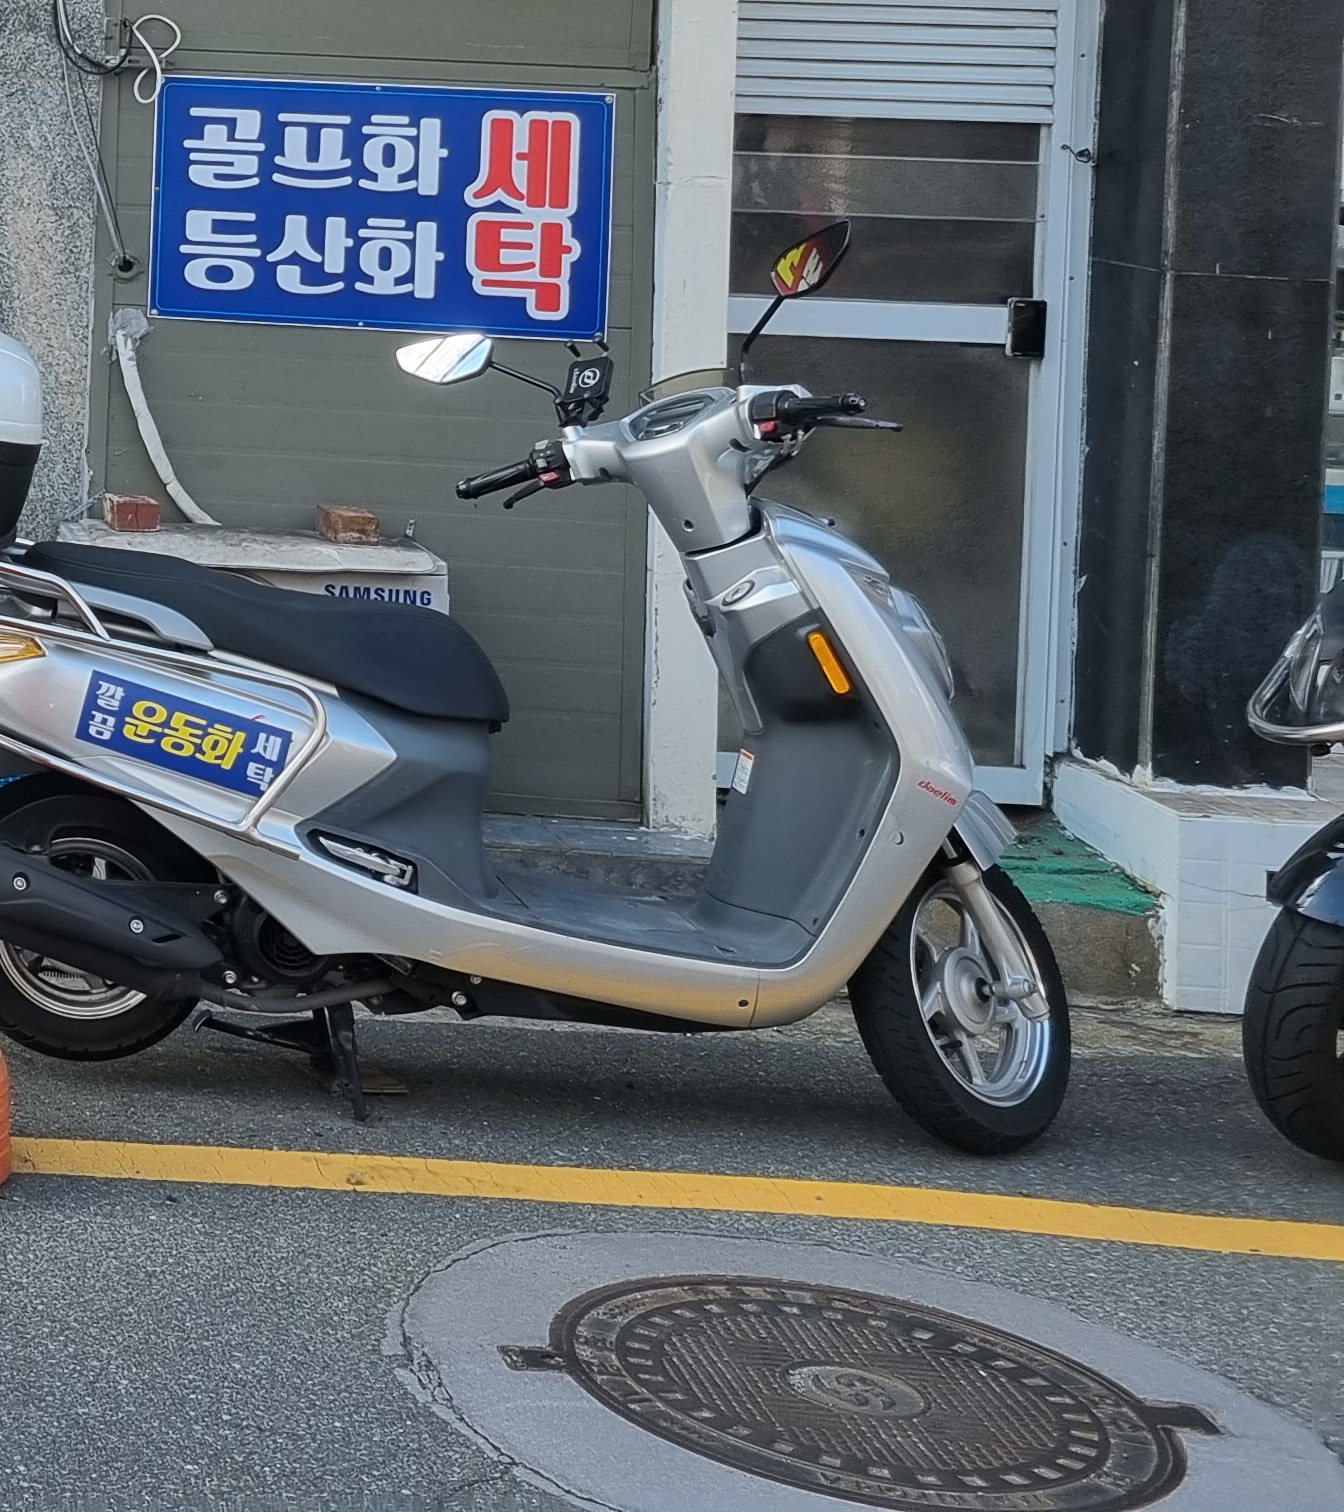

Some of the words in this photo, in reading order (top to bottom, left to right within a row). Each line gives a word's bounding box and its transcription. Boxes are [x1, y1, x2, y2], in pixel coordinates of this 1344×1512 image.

[182, 106, 449, 197] 골프화
[178, 209, 445, 300] 등산화
[463, 110, 582, 321] 세탁
[324, 584, 432, 607] SAMSUNG
[88, 680, 126, 741] 깔끔
[122, 700, 247, 771] 운동화
[246, 732, 283, 792] 세탁
[917, 781, 958, 806] daelim
